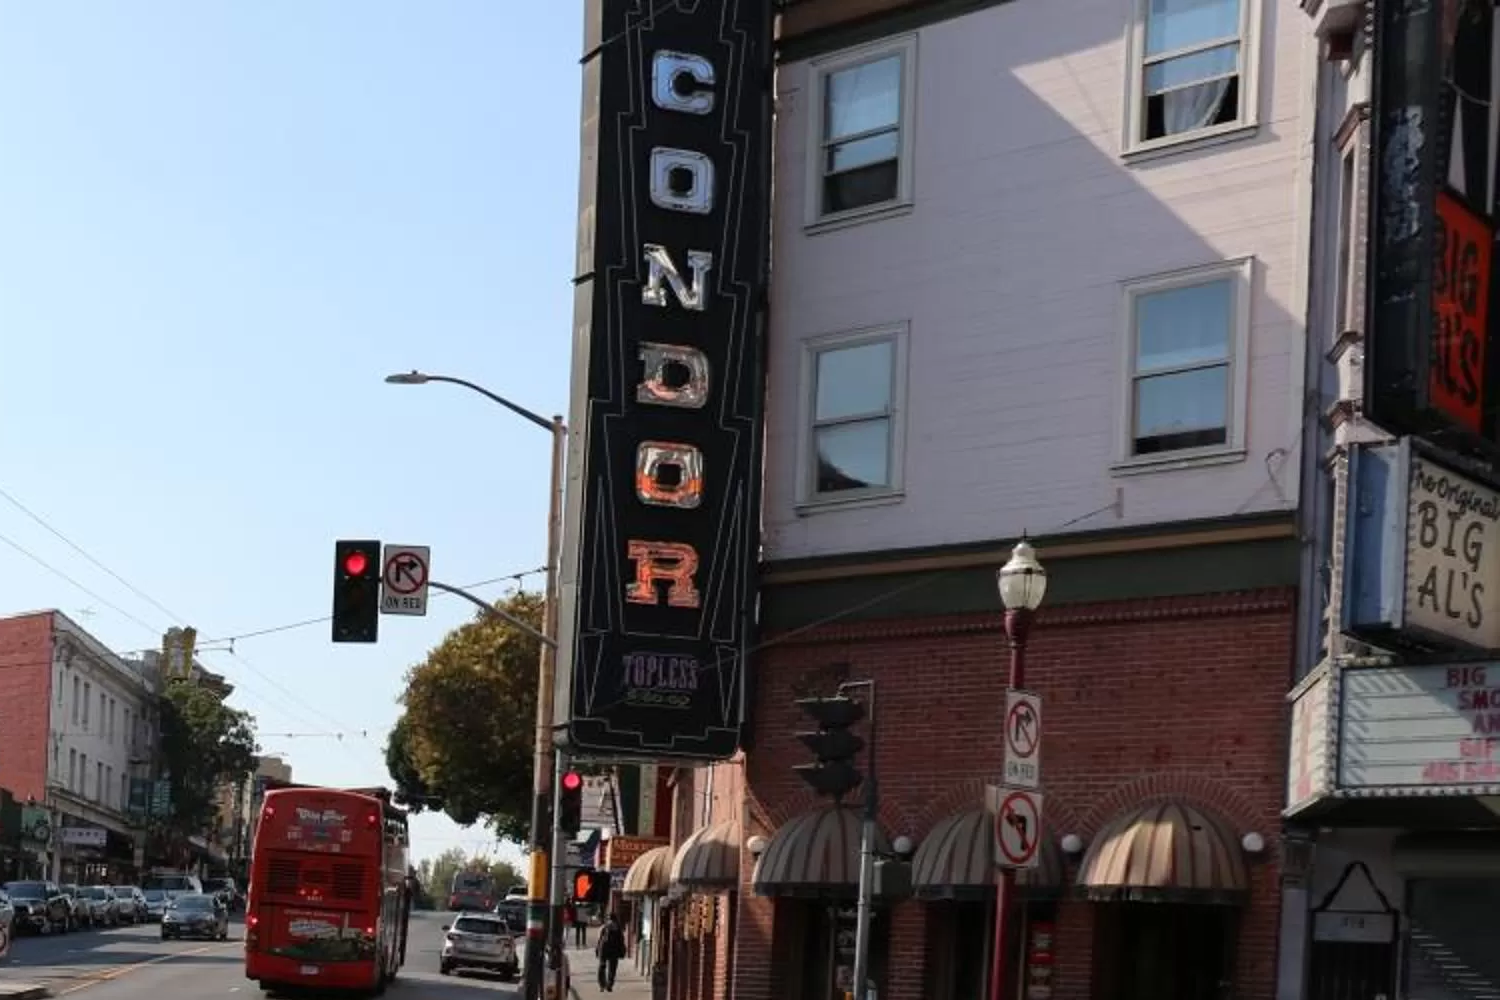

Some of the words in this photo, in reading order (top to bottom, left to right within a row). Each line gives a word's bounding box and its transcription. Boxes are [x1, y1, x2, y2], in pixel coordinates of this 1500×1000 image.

[625, 49, 716, 608] CONDOR
[1437, 476, 1500, 522] Original
[1418, 500, 1484, 572] BIG
[1417, 565, 1484, 629] AL'S
[622, 655, 699, 690] TOPLESS
[1446, 667, 1487, 689] BIG
